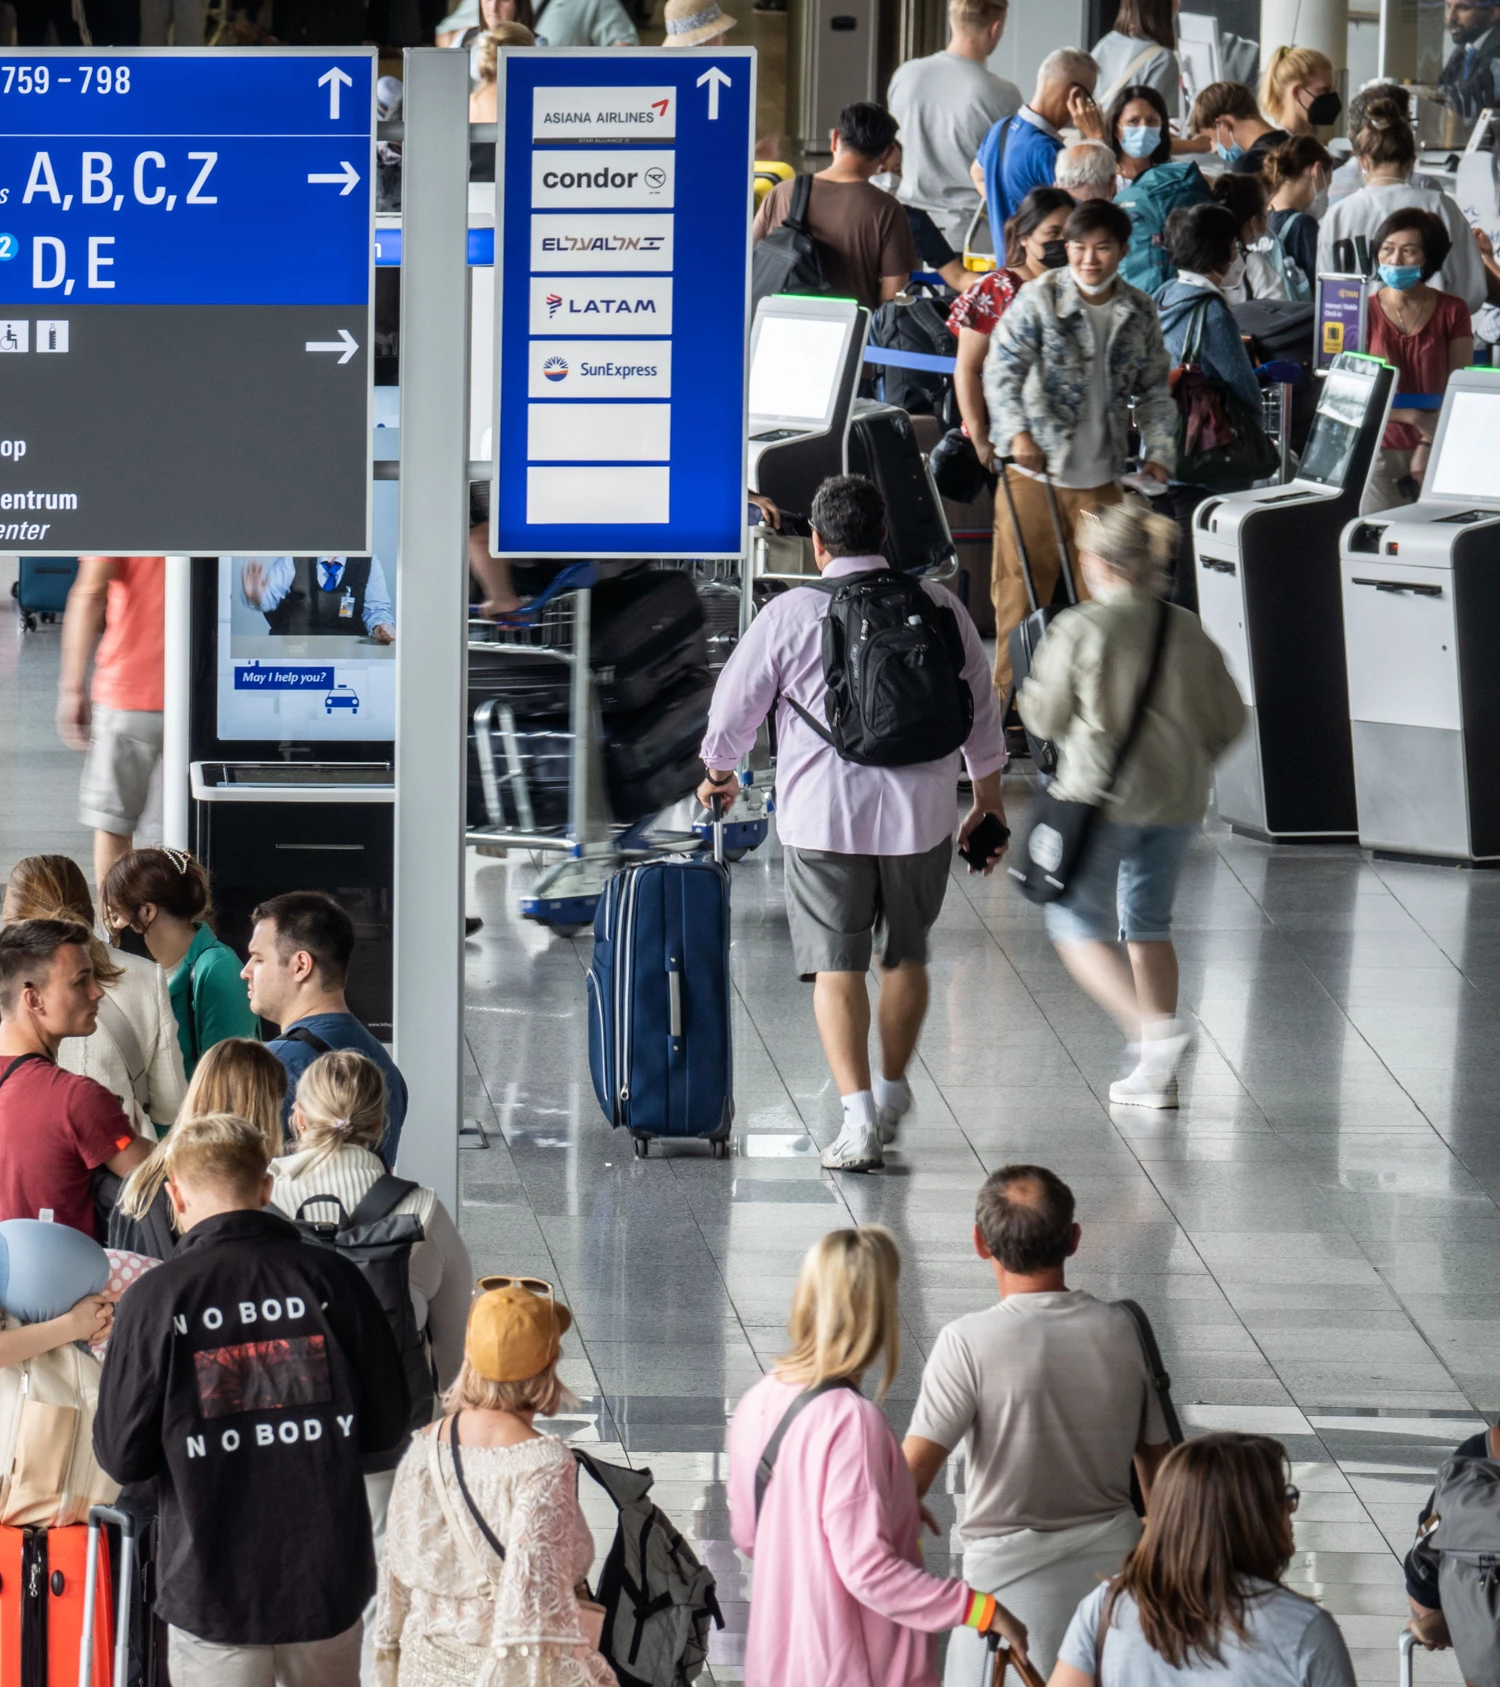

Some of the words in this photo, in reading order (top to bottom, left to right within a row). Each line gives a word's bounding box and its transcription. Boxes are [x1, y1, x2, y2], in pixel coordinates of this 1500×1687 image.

[1, 66, 50, 94] 759
[78, 66, 131, 94] 798
[543, 112, 592, 124] ASIANA
[596, 111, 655, 124] AIRLINES
[542, 166, 639, 189] condor
[569, 299, 657, 314] LATAM
[580, 362, 658, 380] SunExpress
[242, 672, 267, 684] May
[275, 672, 299, 684] help
[300, 672, 327, 684] you?
[173, 1297, 328, 1336] NOBOD
